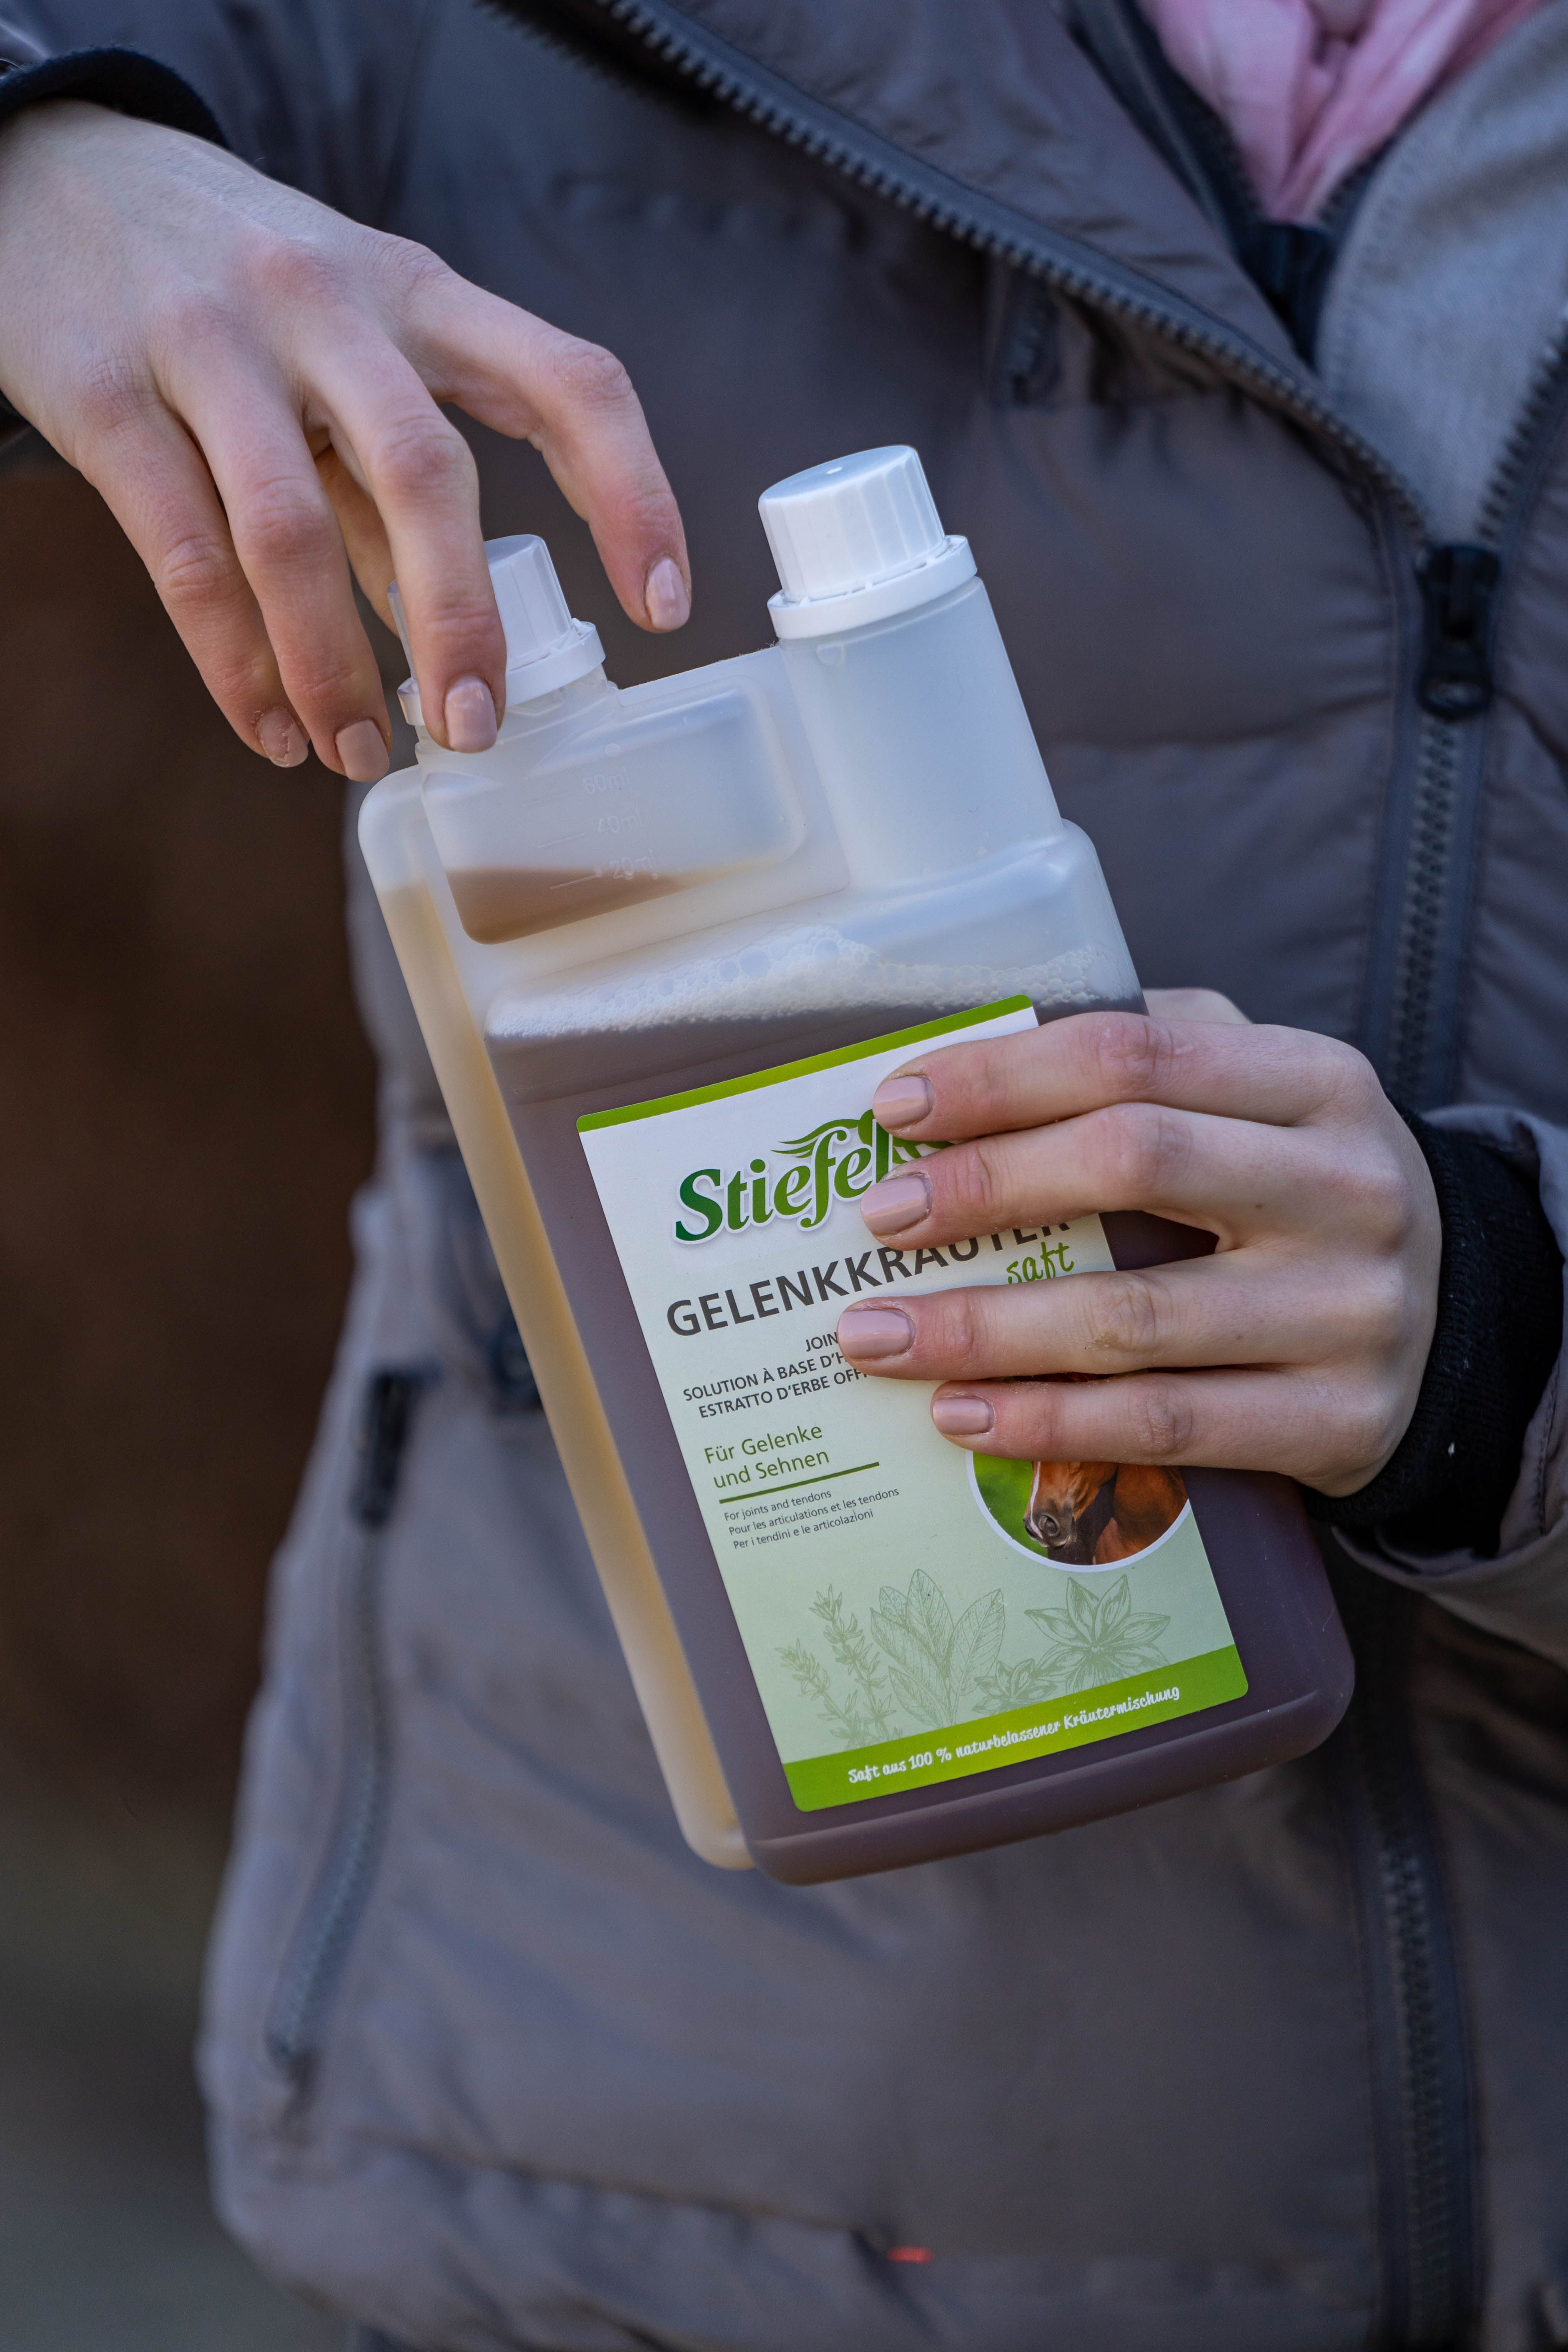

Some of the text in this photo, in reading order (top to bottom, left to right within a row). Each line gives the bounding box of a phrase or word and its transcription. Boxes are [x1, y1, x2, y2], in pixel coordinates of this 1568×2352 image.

[1006, 1242, 1074, 1284] saft
[683, 1374, 758, 1401] SOLUTION
[763, 1368, 775, 1383] À
[777, 1359, 817, 1380] BASE
[699, 1392, 773, 1418] ESTRATTO
[834, 1368, 867, 1385] OFF
[704, 1426, 822, 1464] Für Gelenke
[713, 1451, 829, 1488] und Sehnen
[724, 1490, 832, 1521] For joints and tendons
[729, 1487, 899, 1535] Pour les articulations et les tendons
[733, 1539, 749, 1550] Per
[751, 1537, 755, 1546] i
[756, 1524, 790, 1545] tendini
[801, 1523, 811, 1535] le
[813, 1509, 874, 1532] articolazioni
[848, 1686, 1180, 1783] Saft aus 100 % naturbelassener Kräutermischung
